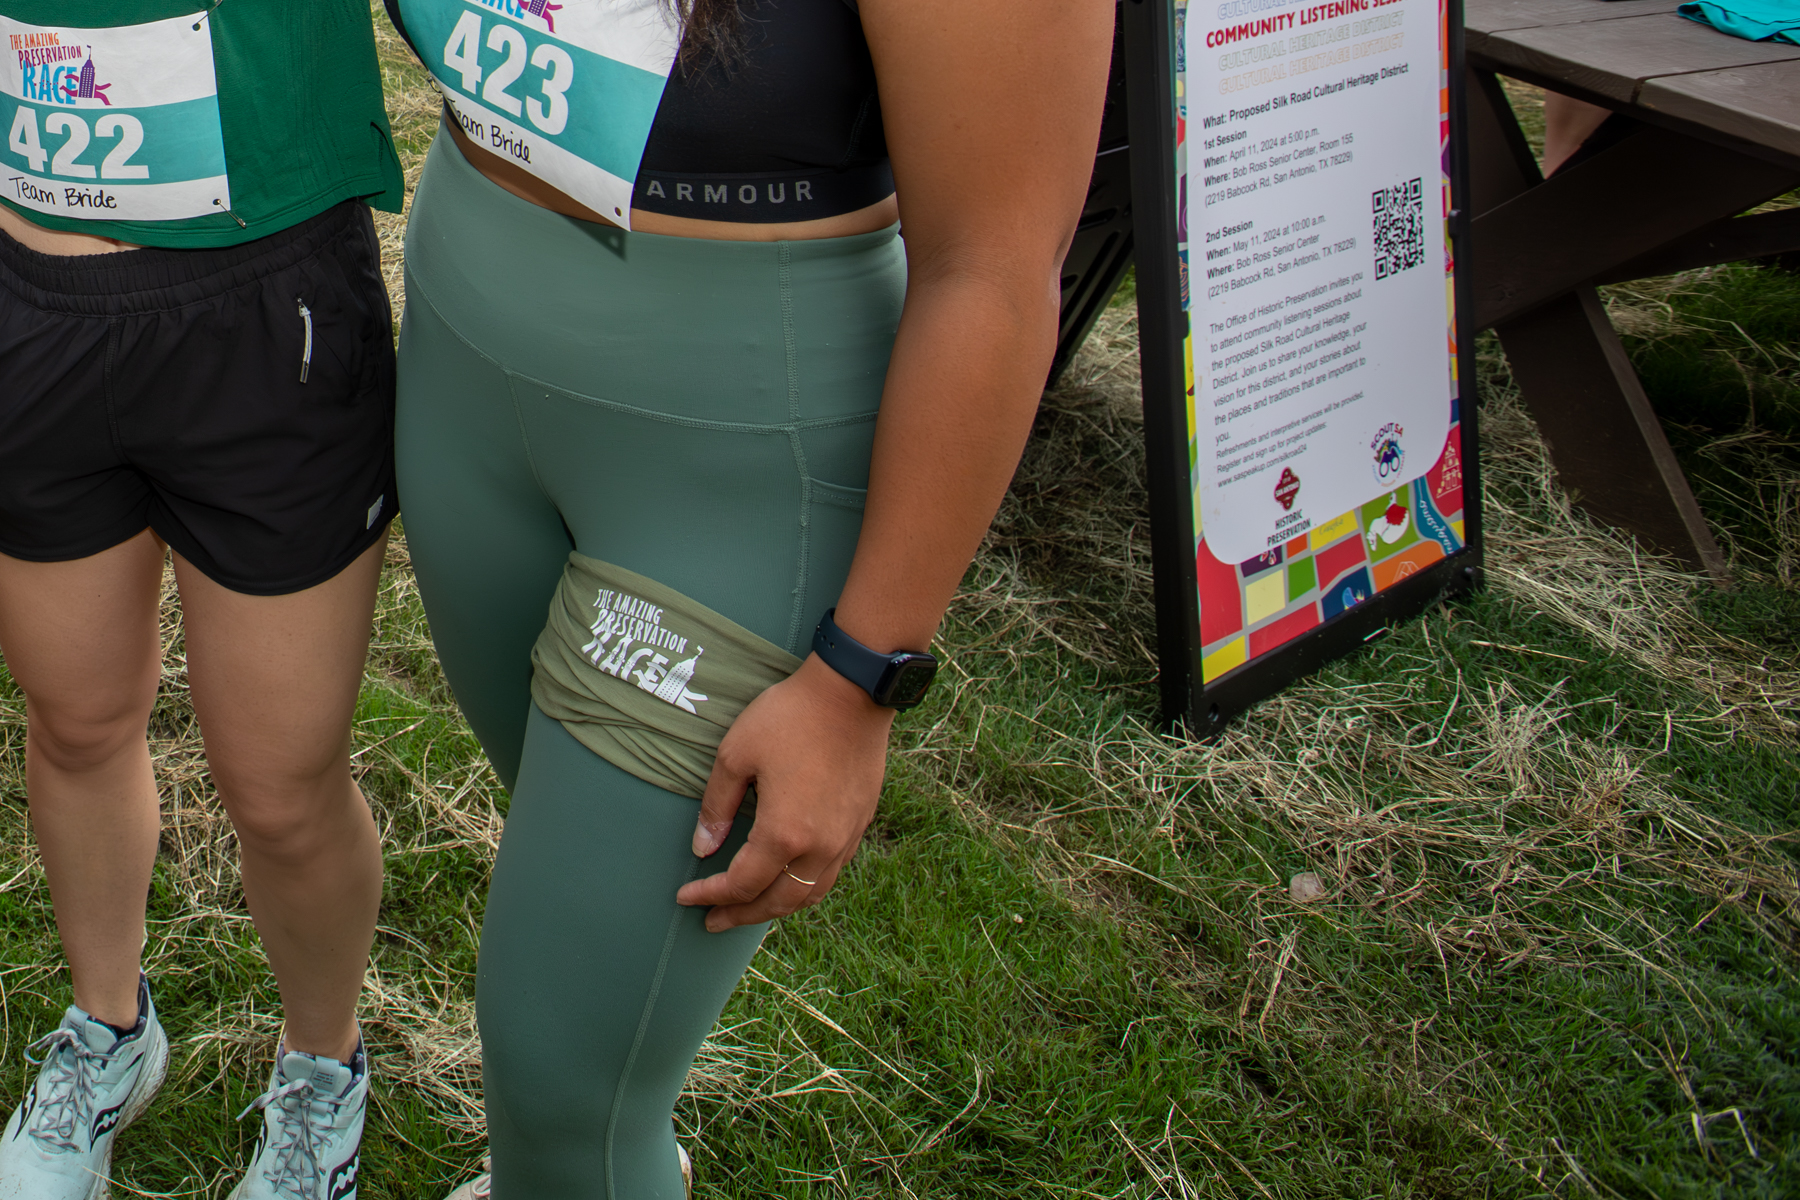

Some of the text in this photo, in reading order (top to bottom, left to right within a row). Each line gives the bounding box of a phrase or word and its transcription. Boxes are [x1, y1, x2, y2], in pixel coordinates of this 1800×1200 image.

[9, 32, 60, 50] THE AMAZING
[1206, 12, 1295, 47] COMMUNITY
[1218, 10, 1404, 71] CULTURAL HERITAGE DISTRICT
[18, 45, 82, 70] PRESERVATION
[443, 9, 575, 136] 423
[1218, 32, 1404, 94] CULTURAL HERITAGE DISTRICT
[23, 60, 77, 105] RACE
[1203, 63, 1408, 129] What: Proposed Silk Road Cultural Heritage District
[8, 105, 149, 179] 422
[490, 124, 531, 164] Bride
[1203, 155, 1227, 168] When:
[1229, 146, 1246, 161] April
[1260, 137, 1278, 152] 2024
[1279, 135, 1287, 146] at
[1288, 129, 1303, 143] 5:00
[1204, 130, 1247, 149] 1st Session
[1204, 172, 1230, 186] Where:
[1232, 165, 1247, 178] Bob
[1249, 161, 1267, 173] Ross
[1269, 153, 1291, 167] Senior
[1319, 139, 1339, 151] Room
[1341, 132, 1353, 144] 155
[8, 176, 117, 209] Team Bride
[646, 180, 813, 204] ARMOUR
[1204, 190, 1225, 208] (2219
[1226, 181, 1258, 198] Babcock
[1273, 173, 1287, 184] San
[1318, 158, 1328, 169] TX
[1330, 151, 1352, 165] 78229)
[1206, 220, 1253, 243] 2nd Session
[1206, 246, 1230, 260] When:
[1233, 240, 1248, 251] May
[1263, 227, 1281, 242] 2024
[1282, 225, 1290, 236] at
[1291, 217, 1310, 232] 10:00
[1206, 234, 1319, 279] Where: Bob Ross Senior Center
[1207, 281, 1229, 300] (2219
[1230, 271, 1262, 290] Babcock
[1277, 262, 1291, 273] San
[1322, 245, 1332, 256] TX
[1333, 237, 1356, 252] 78229)
[1209, 272, 1363, 333] The Office of Historic Preservation invites you
[1210, 288, 1362, 353] to attend community listening sessions about
[1211, 311, 1350, 371] the proposed Silk Road Cultural Heritage
[1241, 364, 1257, 378] Join
[1258, 361, 1267, 371] us
[1268, 358, 1276, 367] to
[1277, 350, 1297, 364] share
[1298, 343, 1313, 358] your
[1352, 321, 1366, 336] your
[1213, 392, 1234, 407] vision
[1235, 387, 1246, 398] for
[1247, 382, 1261, 394] this
[1288, 364, 1302, 378] and
[1303, 359, 1318, 374] your
[1319, 350, 1341, 365] stories
[1342, 340, 1361, 355] about
[1214, 357, 1366, 425] the places and traditions that are important to
[1370, 422, 1404, 450] SCOUT SA
[1267, 518, 1310, 546] PRESERVATION
[1275, 509, 1302, 529] HISTORIC
[593, 588, 664, 625] THE AMAZING
[589, 608, 688, 654] PRESERVATION
